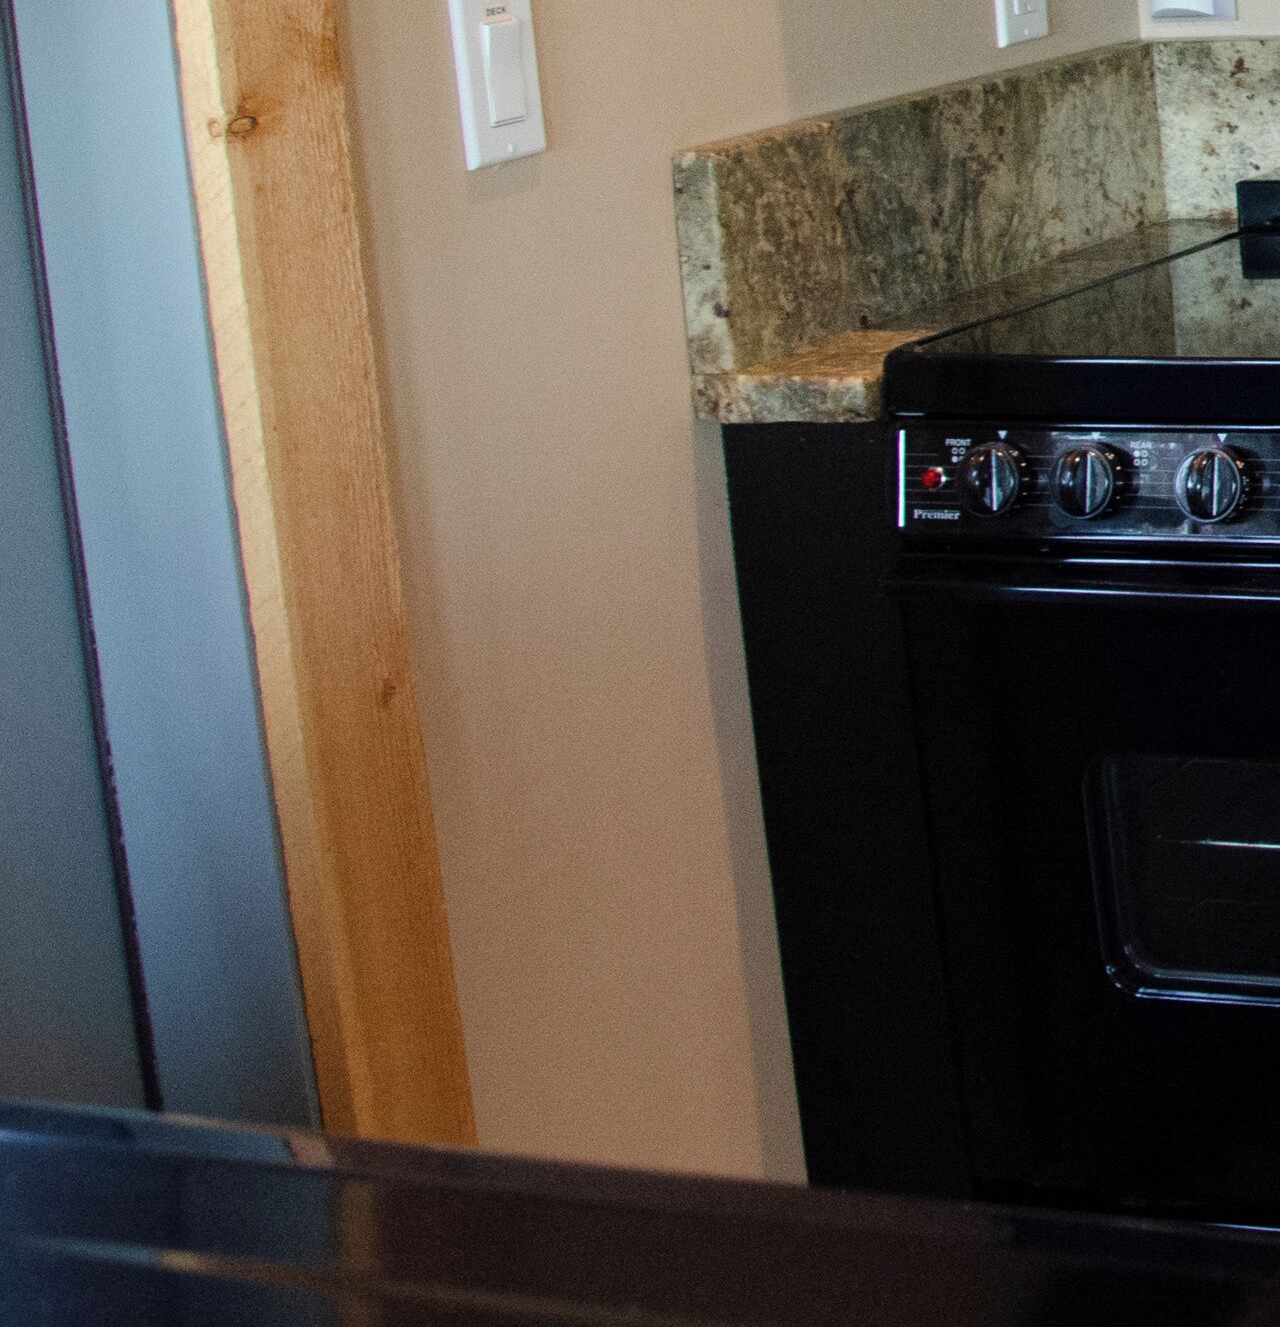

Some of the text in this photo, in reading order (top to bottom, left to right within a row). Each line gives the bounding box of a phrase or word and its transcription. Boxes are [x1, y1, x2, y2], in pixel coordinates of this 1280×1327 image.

[486, 6, 506, 17] DECK
[945, 438, 971, 446] FRONT
[913, 509, 960, 520] Premier
